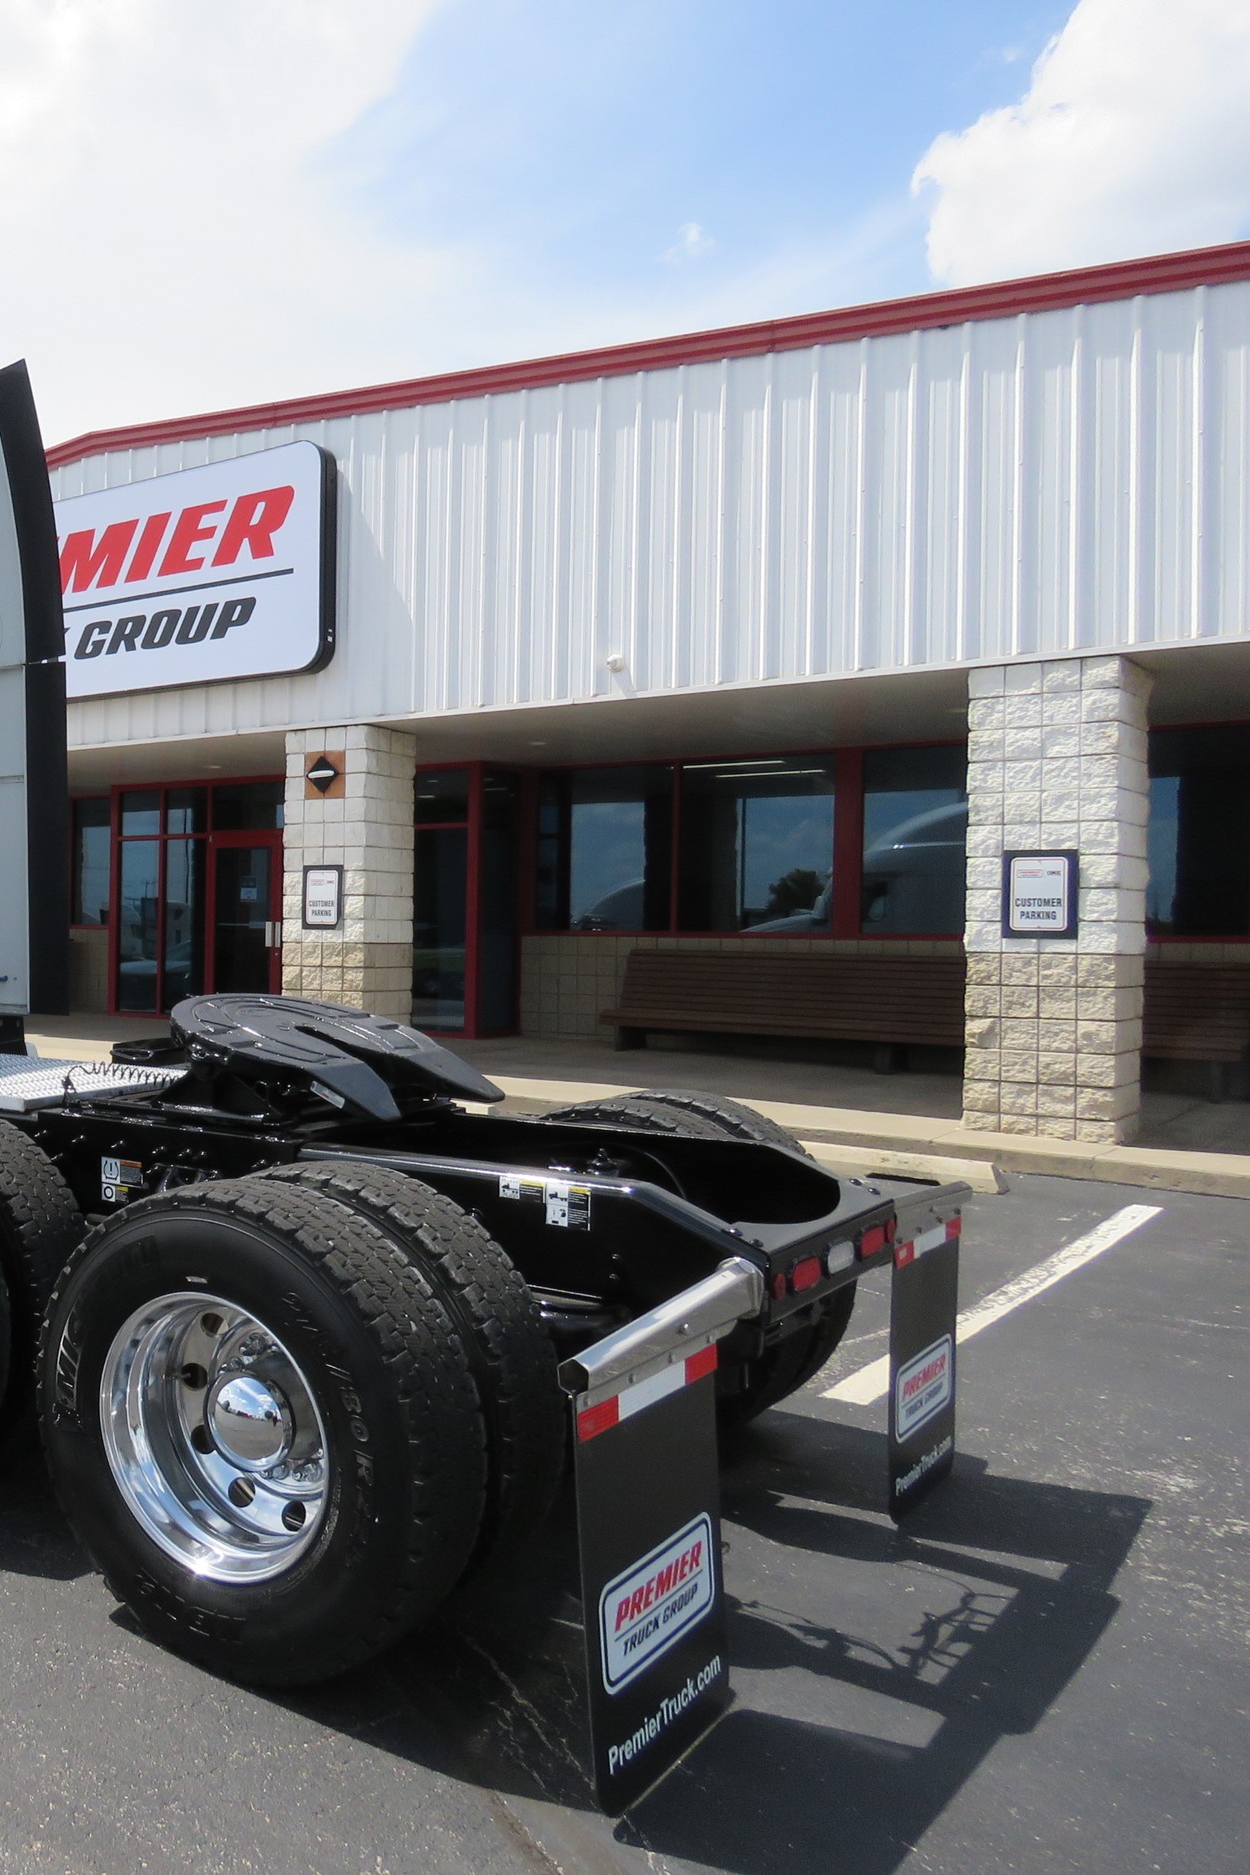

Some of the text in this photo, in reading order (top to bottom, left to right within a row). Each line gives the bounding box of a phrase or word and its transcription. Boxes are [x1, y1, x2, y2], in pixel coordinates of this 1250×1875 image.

[58, 485, 295, 595] MIER
[74, 597, 257, 660] GROUP
[309, 899, 334, 908] CUSTOMER
[311, 909, 332, 917] PARKING
[1015, 897, 1062, 907] CUSTOMER
[1020, 910, 1057, 920] PARKING
[902, 1353, 946, 1400] PREMIER
[614, 1540, 703, 1632] PREMIER
[622, 1582, 699, 1657] TRUCK GROUP
[608, 1654, 721, 1775] PremierTruck.com
